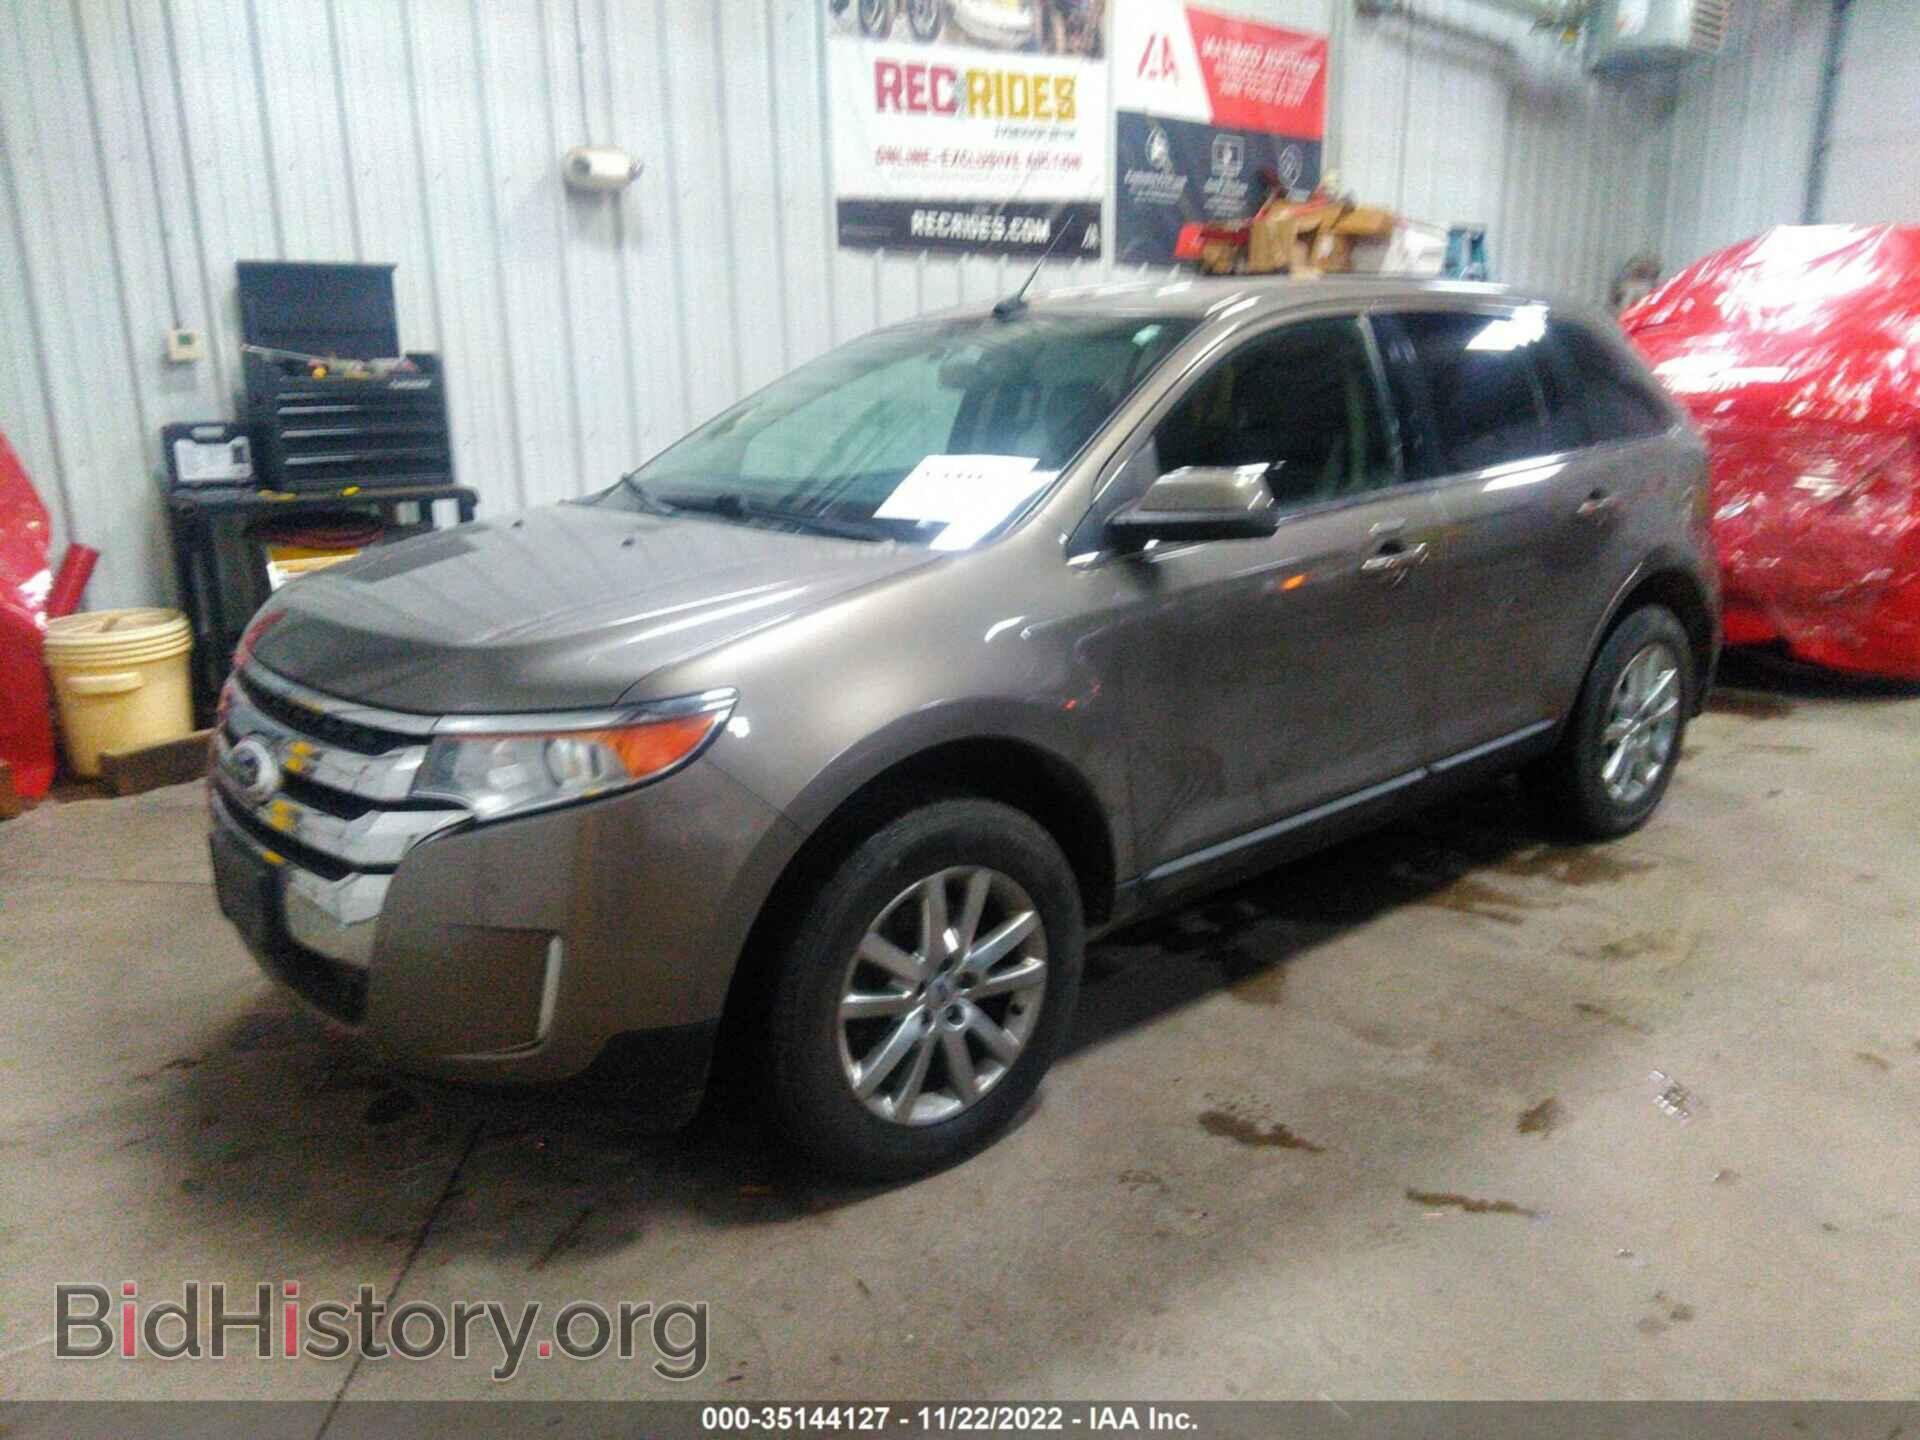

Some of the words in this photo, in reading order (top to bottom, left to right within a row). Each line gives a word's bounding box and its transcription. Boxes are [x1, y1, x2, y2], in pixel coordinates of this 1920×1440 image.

[873, 59, 957, 117] REC
[964, 69, 1077, 121] RIDES
[910, 208, 1051, 244] RECRIDES.COM
